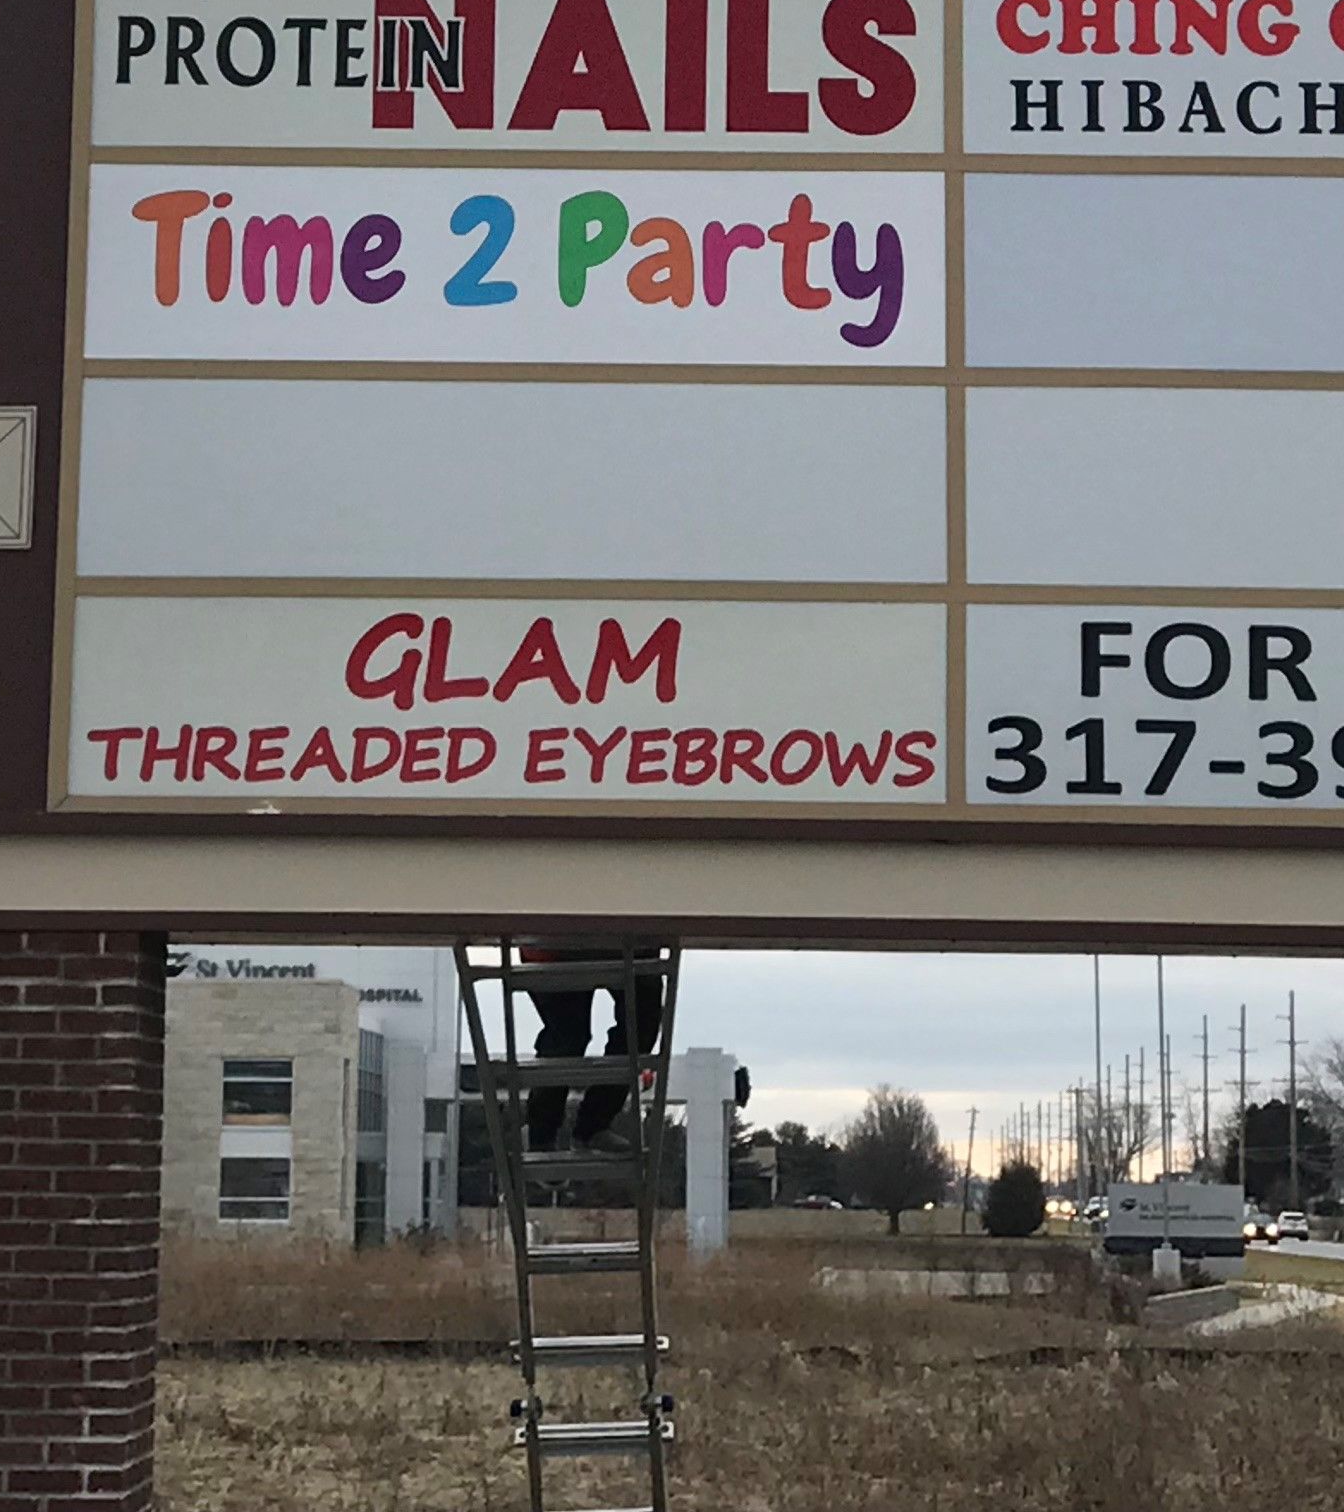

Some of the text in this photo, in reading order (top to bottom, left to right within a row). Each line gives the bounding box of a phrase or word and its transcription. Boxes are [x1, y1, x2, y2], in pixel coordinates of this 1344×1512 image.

[114, 14, 466, 92] PROTEIN
[132, 190, 904, 348] Time 2 Party
[345, 613, 681, 711] GLAM
[1081, 622, 1317, 702] FOR
[87, 724, 936, 787] THREADED EYEBROWS
